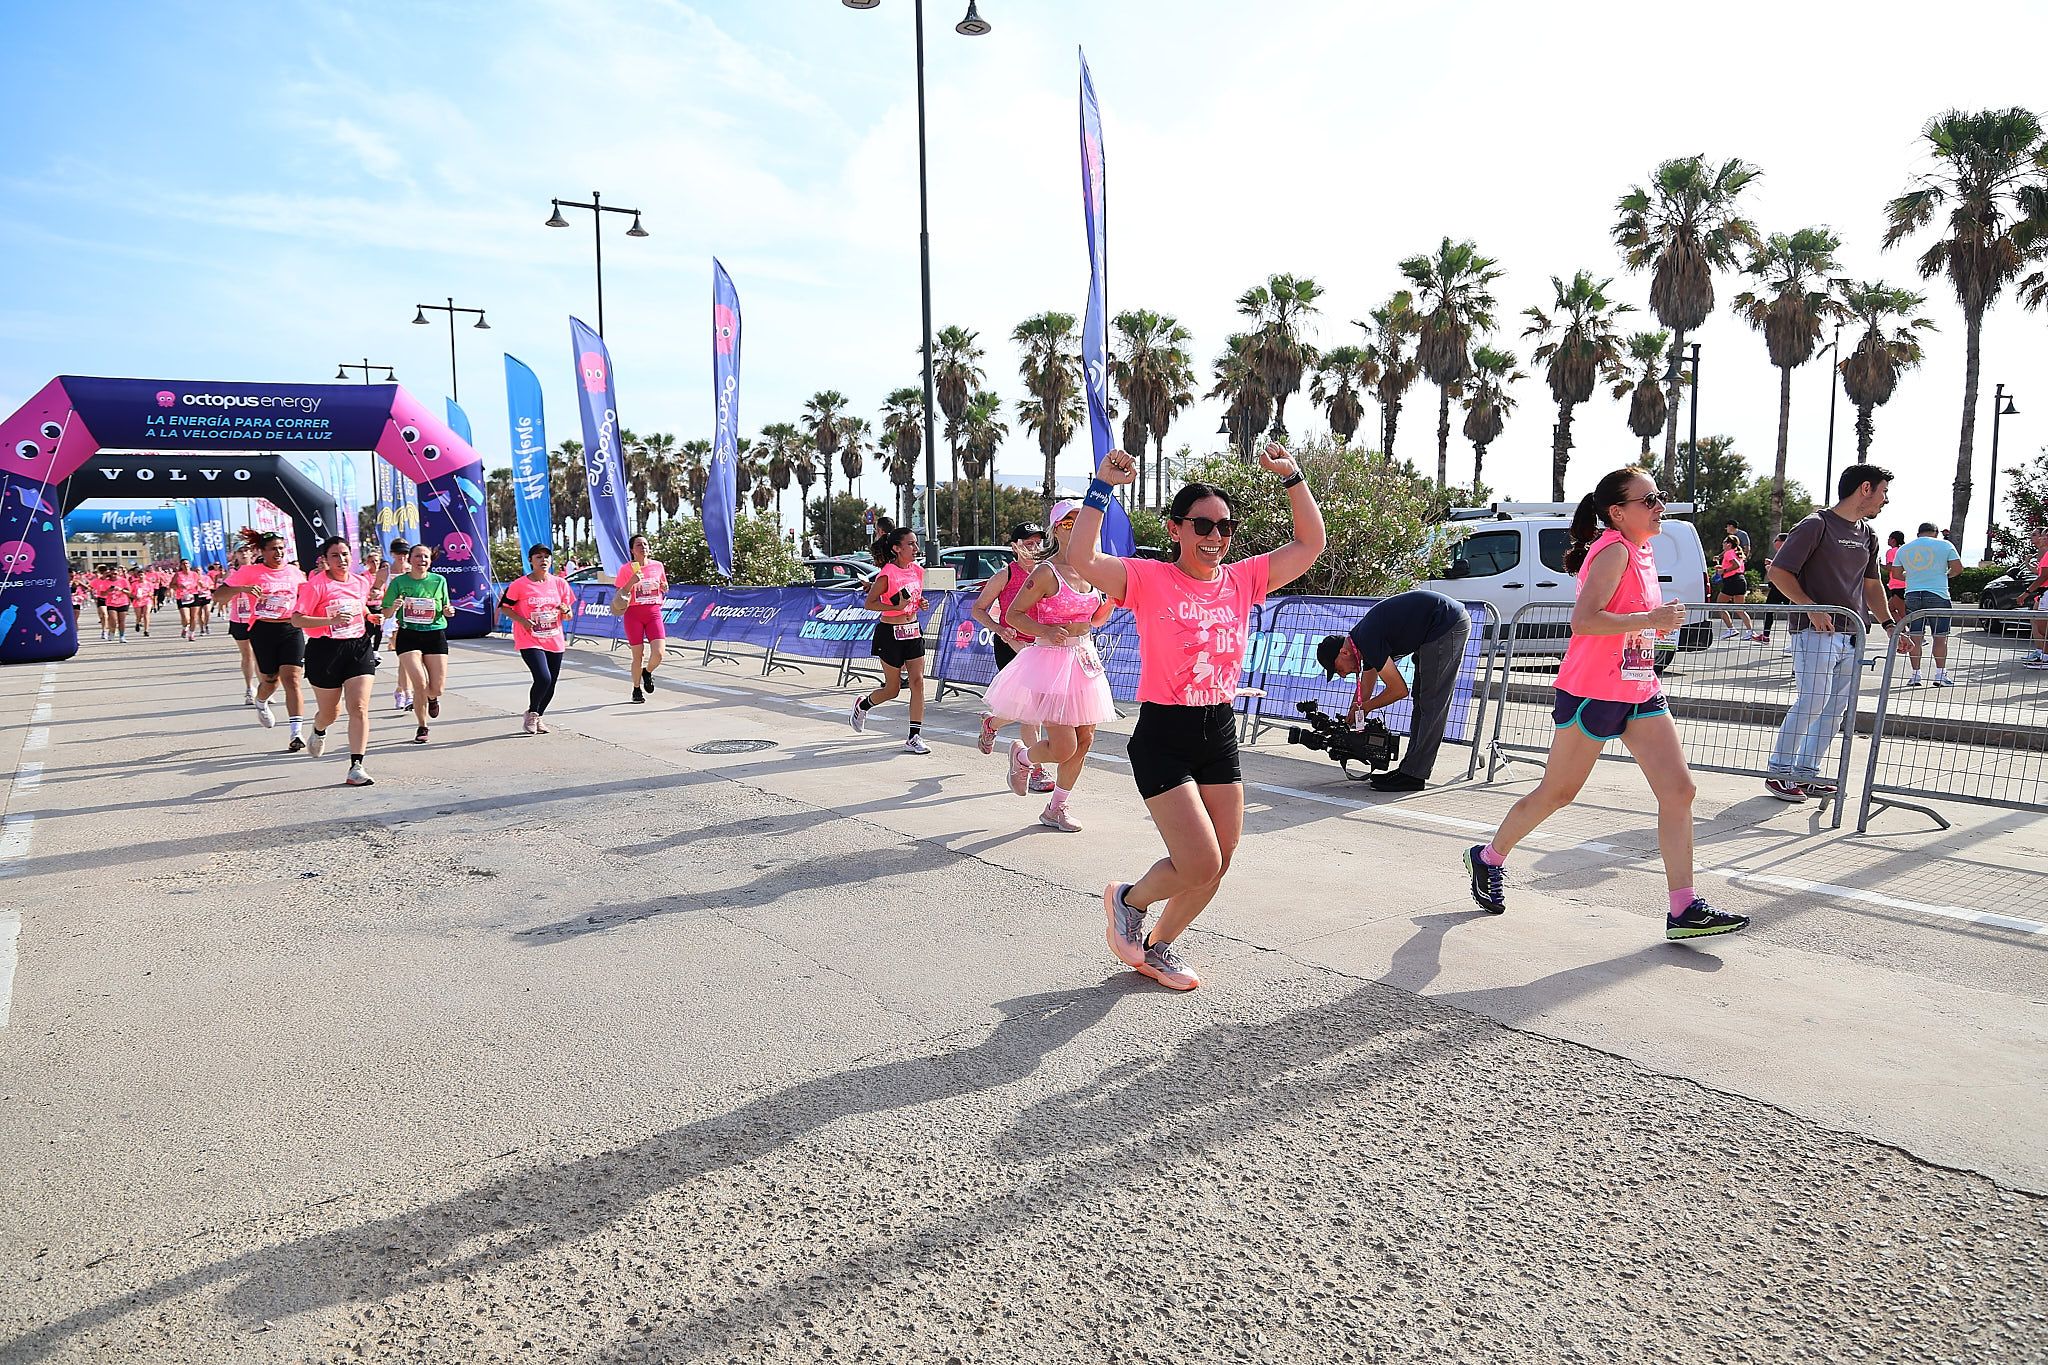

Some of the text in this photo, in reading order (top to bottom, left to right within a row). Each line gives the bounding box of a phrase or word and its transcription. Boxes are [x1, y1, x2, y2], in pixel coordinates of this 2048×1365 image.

[146, 414, 330, 429] LA ENERGÍA PARA CORRER
[145, 428, 333, 440] A LA VELOCIDAD DE LA LUZ
[98, 468, 252, 481] VOLVO
